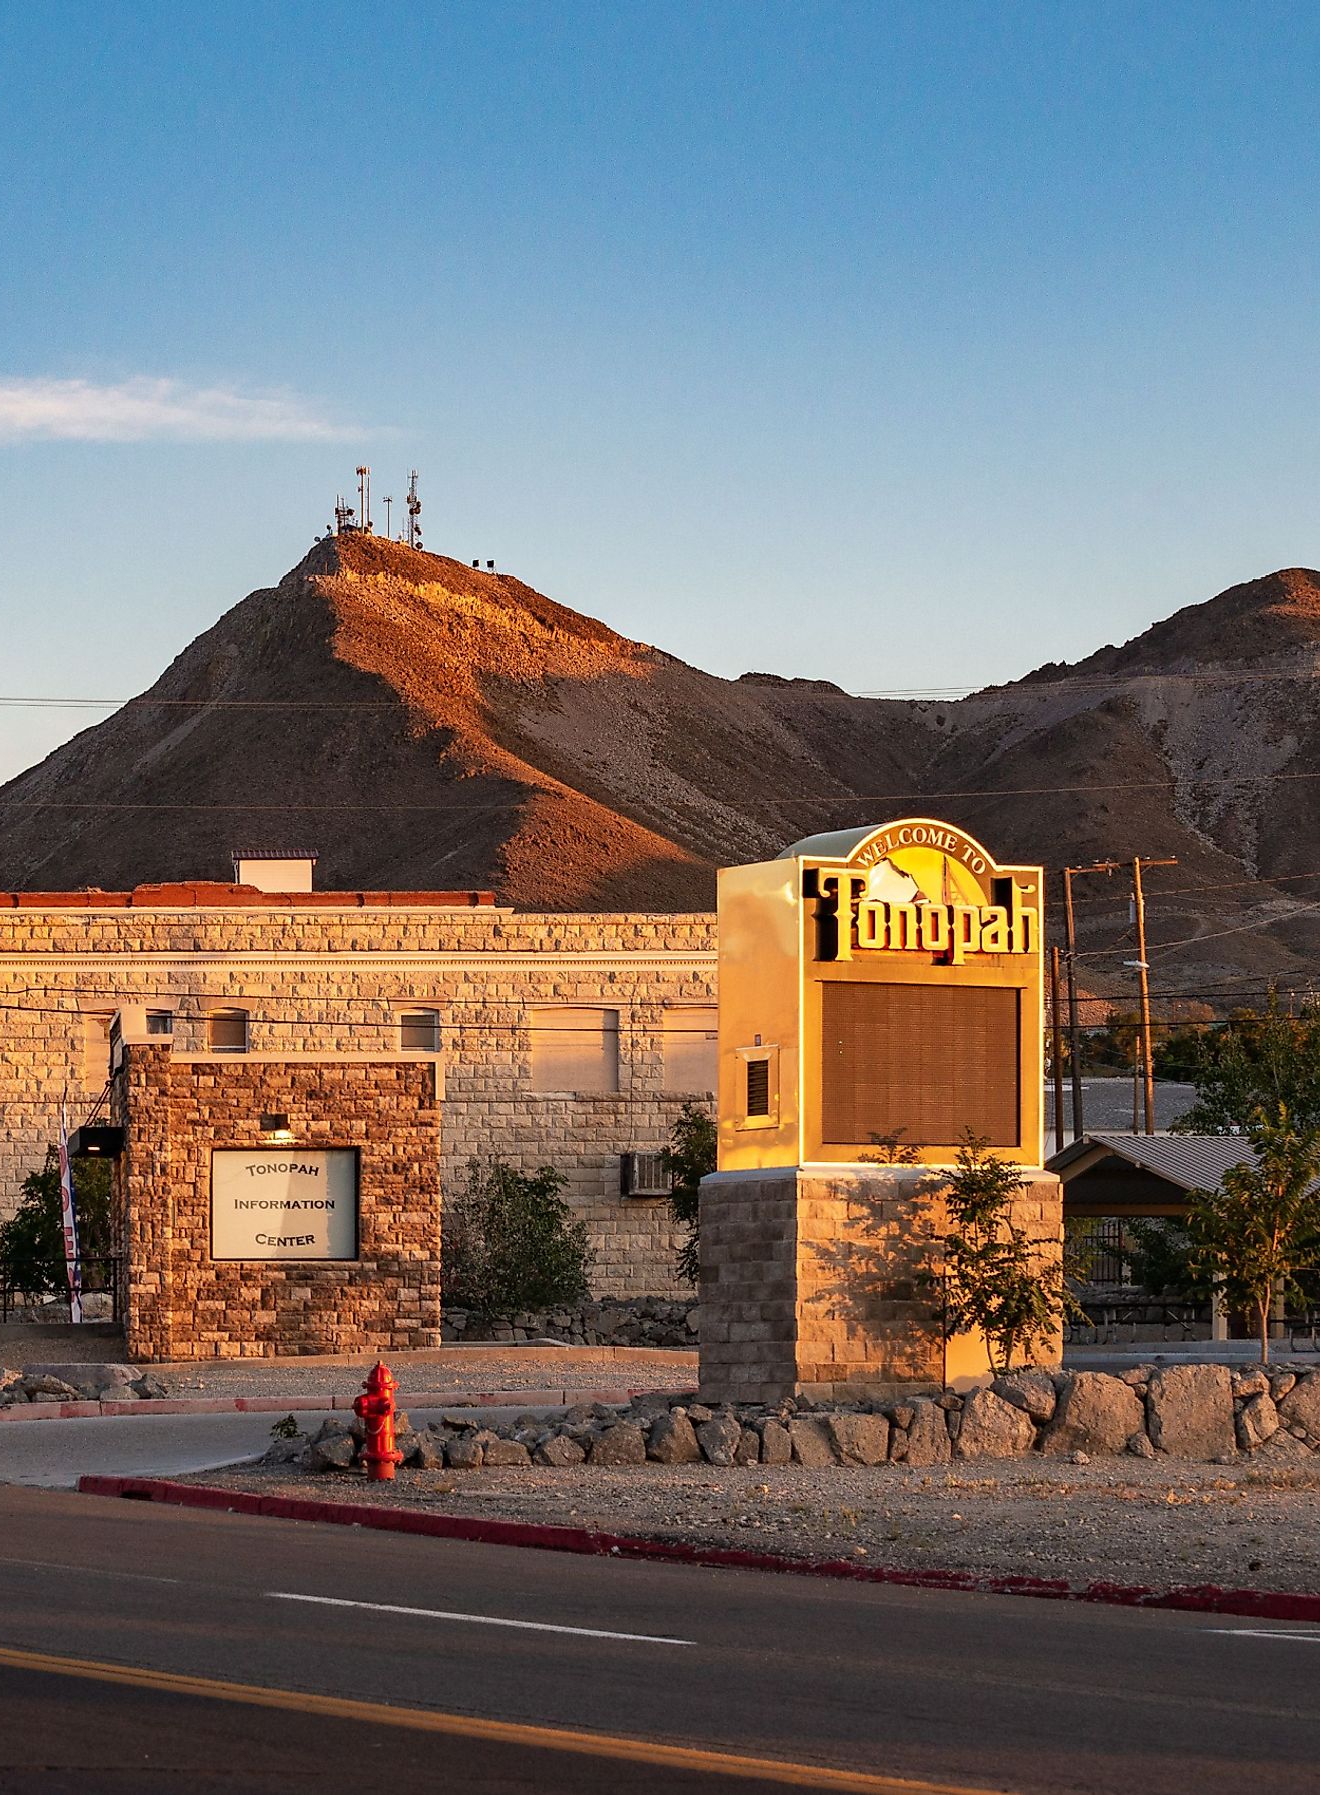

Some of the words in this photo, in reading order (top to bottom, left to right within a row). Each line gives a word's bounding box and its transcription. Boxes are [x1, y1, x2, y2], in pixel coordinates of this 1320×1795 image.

[856, 827, 958, 868] WELCOME
[961, 845, 987, 875] TO
[817, 867, 1040, 966] Tonopah
[246, 1163, 319, 1176] TONOPAH
[234, 1199, 335, 1209] INFORMATION
[255, 1233, 316, 1247] CENTER
